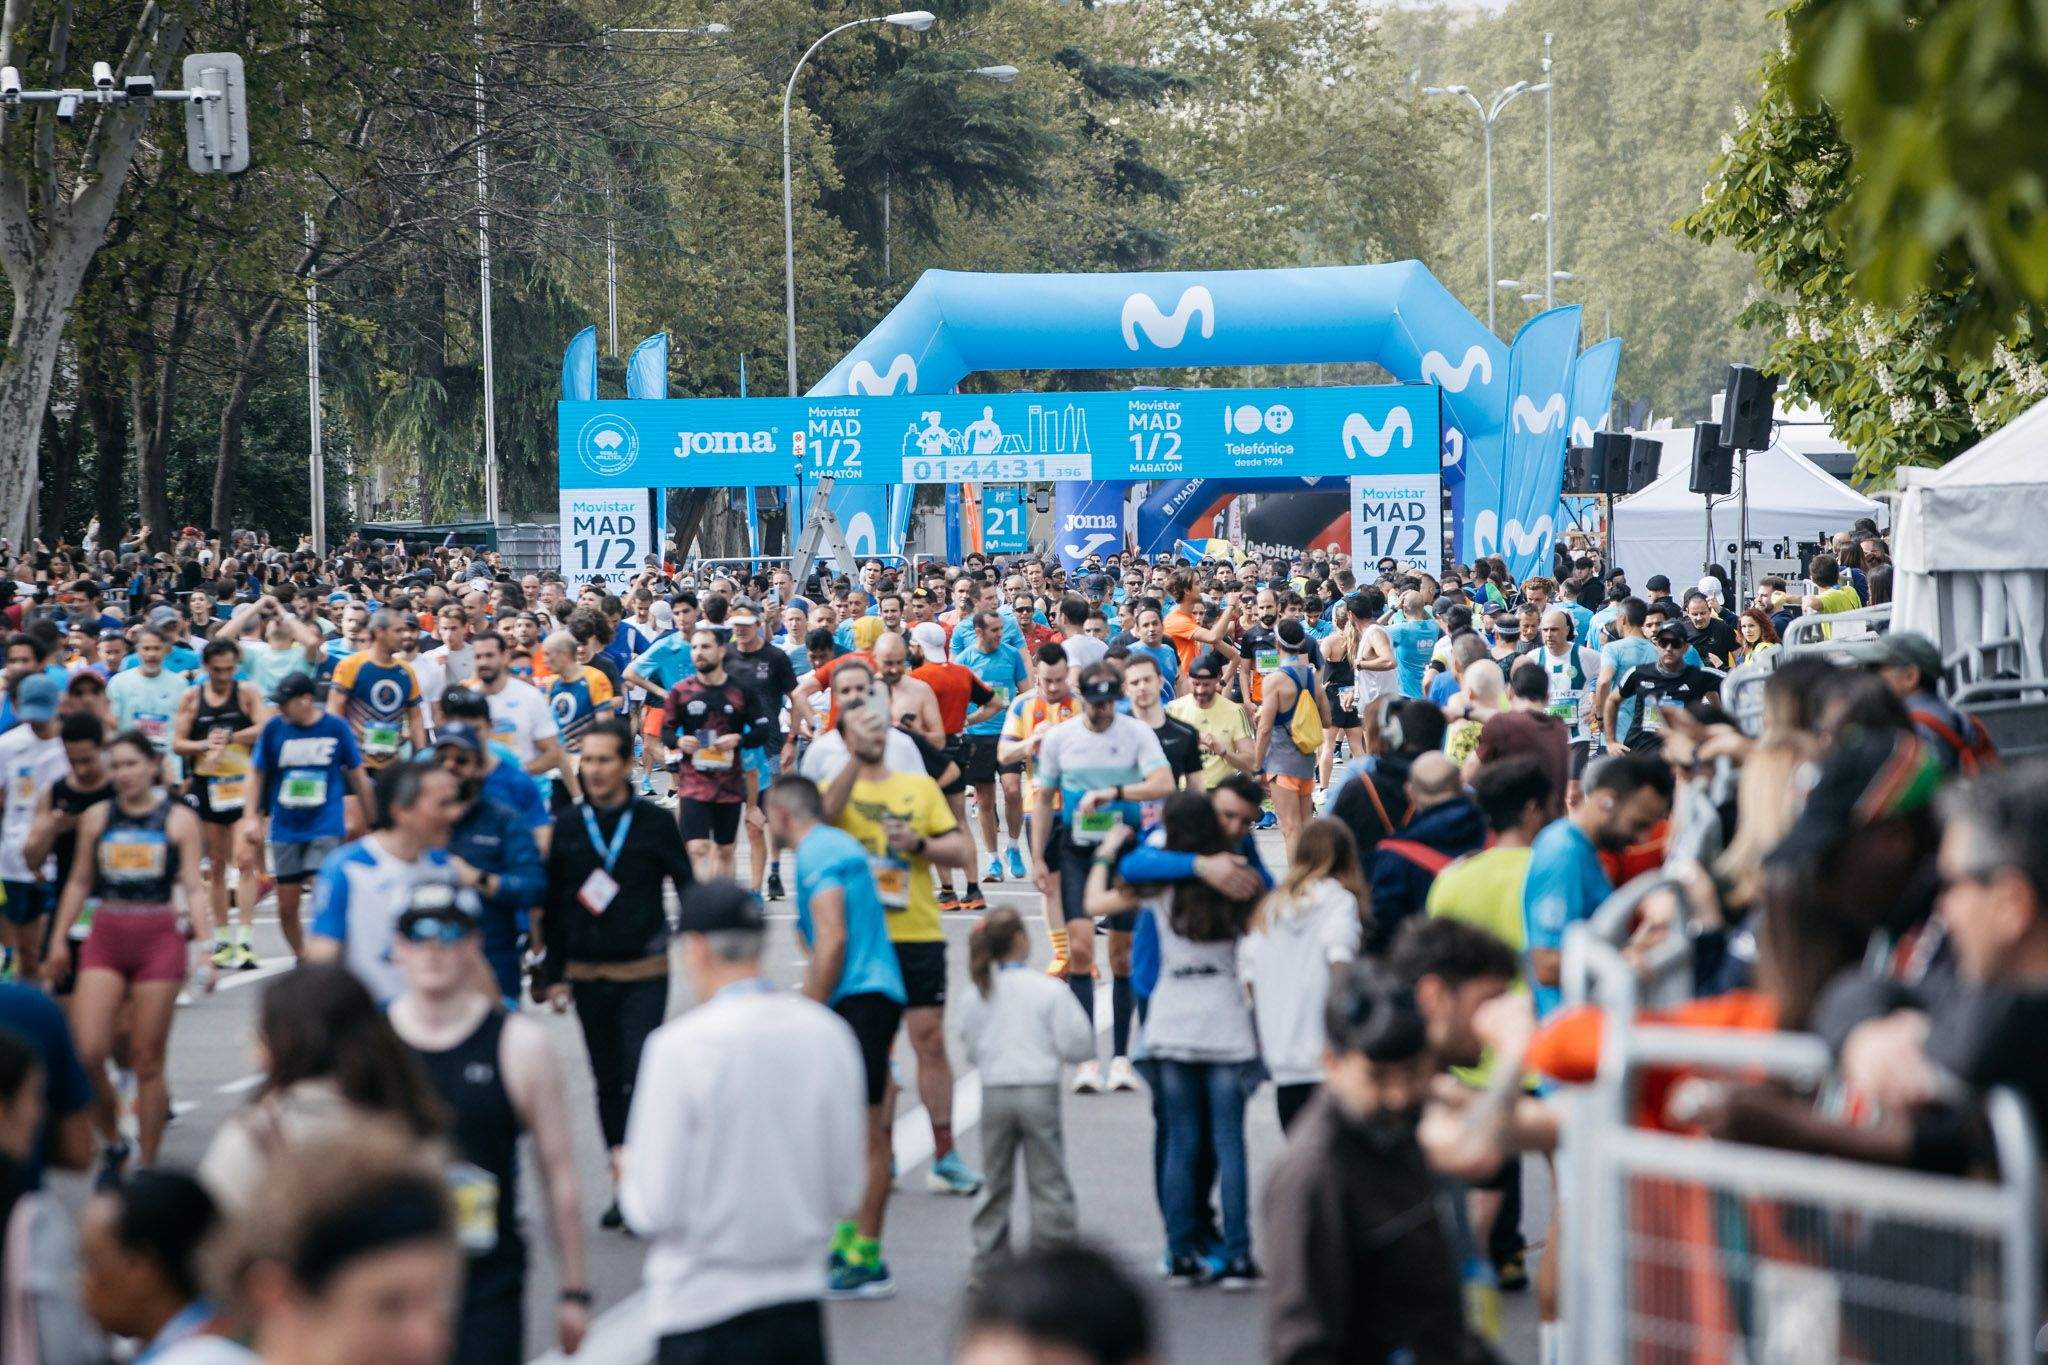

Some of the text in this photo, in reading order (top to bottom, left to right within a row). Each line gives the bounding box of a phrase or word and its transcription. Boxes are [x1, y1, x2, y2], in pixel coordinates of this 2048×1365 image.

[808, 406, 861, 417] Movistar
[1128, 400, 1181, 411] Movistar
[808, 419, 861, 437] MAD
[1128, 413, 1182, 430] MAD
[809, 438, 862, 467] 1/2
[1129, 432, 1183, 461] 1/2
[1224, 442, 1294, 455] Telefónica
[1129, 462, 1183, 473] MARATÓN
[1234, 458, 1283, 466] desde 1924
[1362, 488, 1425, 499] Movistar
[573, 501, 636, 512] Movistar
[1363, 502, 1426, 522] MAD
[574, 515, 636, 535] MAD
[986, 507, 1019, 536] 21
[1363, 525, 1427, 556] 1/2
[574, 538, 637, 569] 1/2
